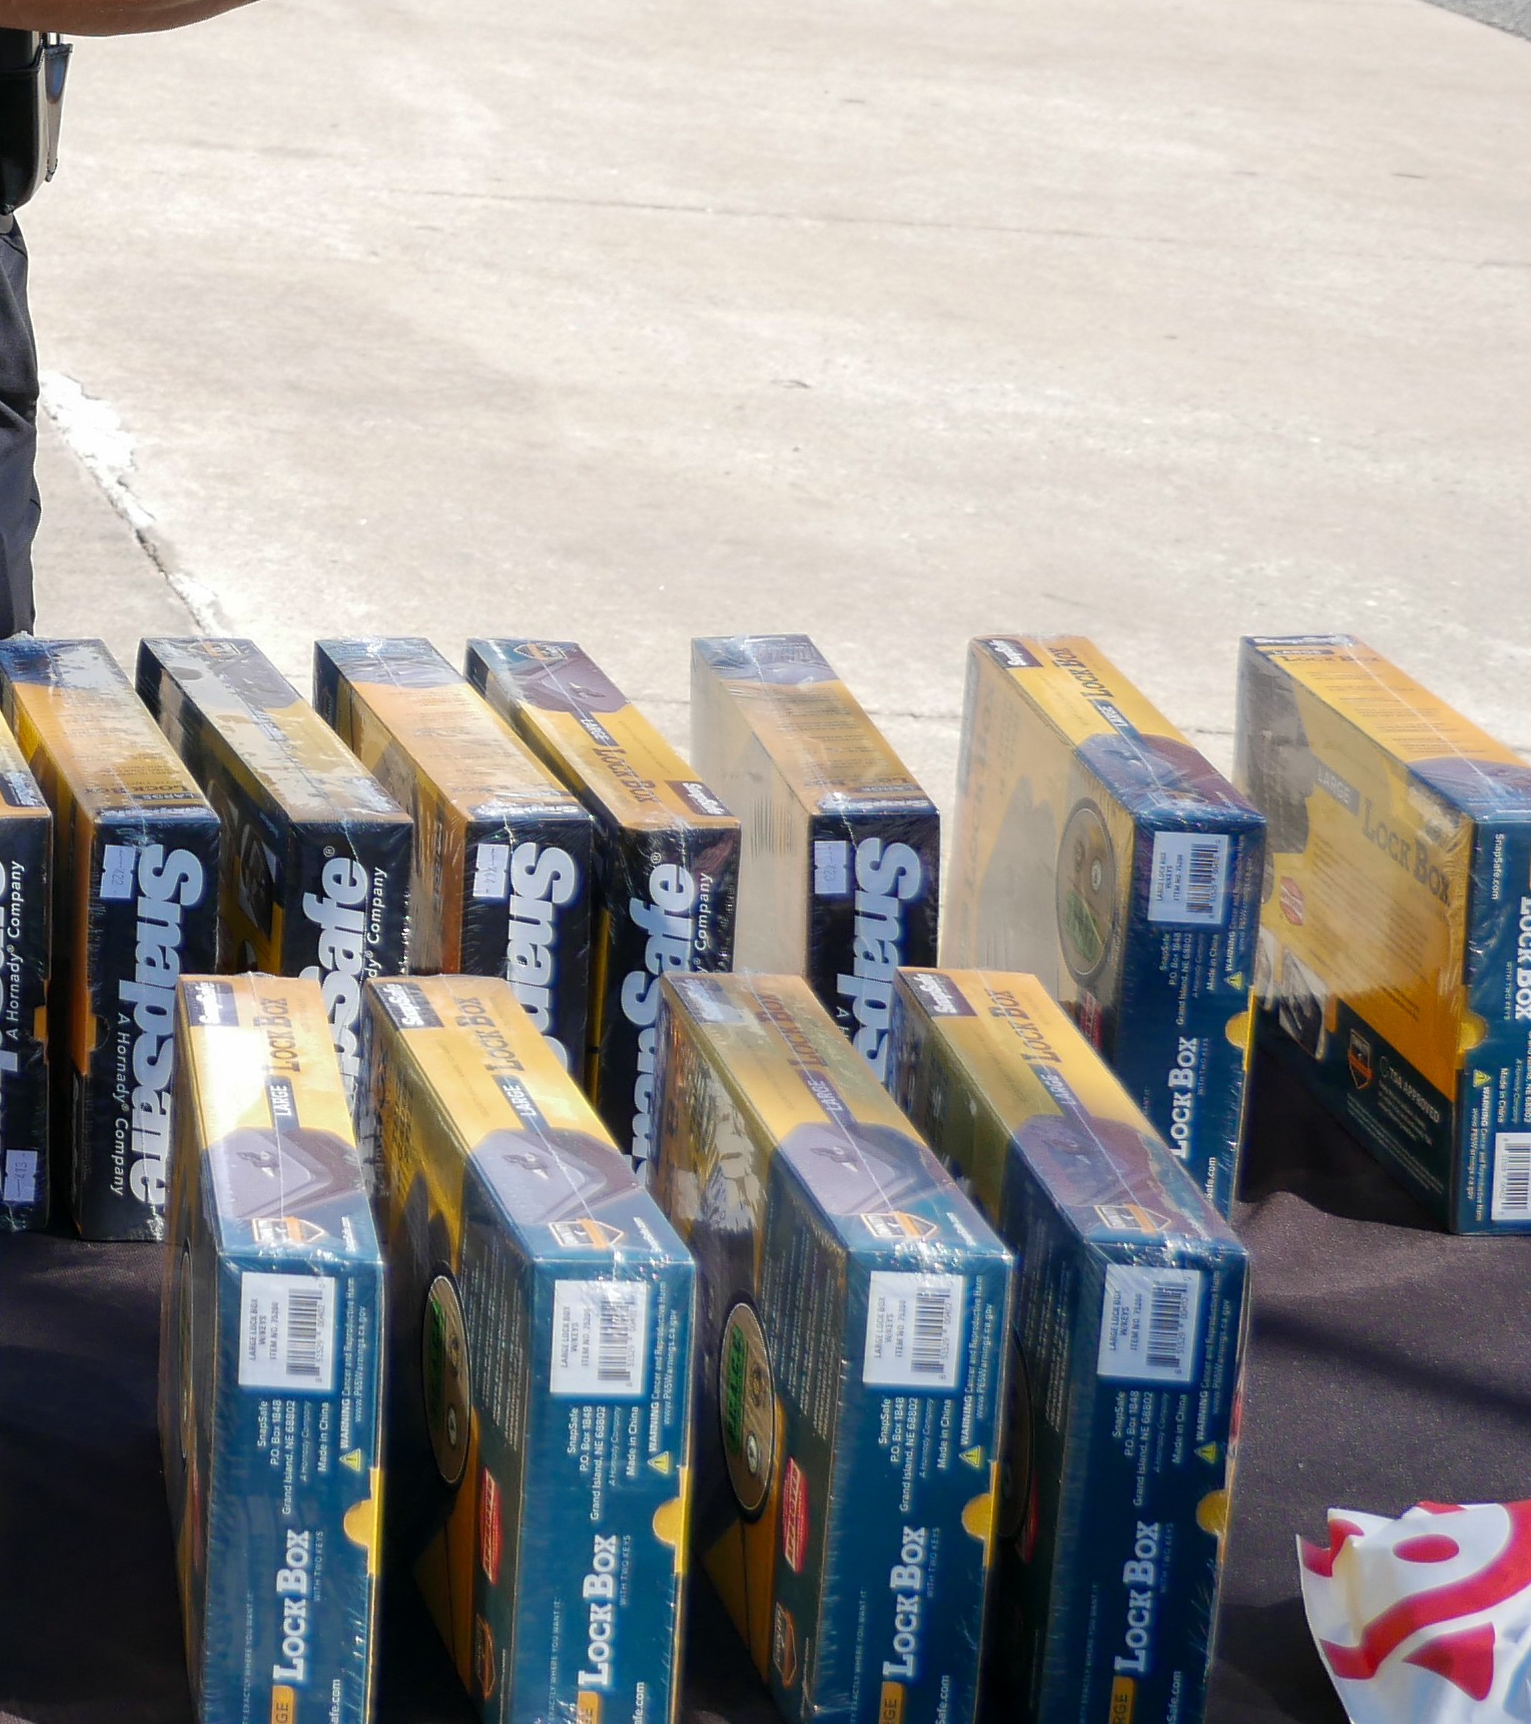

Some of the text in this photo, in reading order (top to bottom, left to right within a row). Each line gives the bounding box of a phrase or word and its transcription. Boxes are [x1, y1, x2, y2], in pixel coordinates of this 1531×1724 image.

[1318, 768, 1350, 805] LARGE
[5, 860, 26, 939] Company
[367, 866, 388, 945] Company
[1491, 832, 1505, 900] SnapSafe.com
[694, 872, 713, 952] Company
[6, 1027, 19, 1040] A
[115, 1013, 129, 1026] A
[252, 997, 301, 1117] LARGE LOCK BOX
[453, 996, 538, 1117] LARGE LOCK BOX
[1168, 1036, 1199, 1159] LOCK BOX
[110, 1117, 130, 1196] Company
[257, 1400, 269, 1447] SnapSafe
[270, 1398, 282, 1466] P.O. Box 1848
[282, 1399, 296, 1516] Grand Island, NE 68802
[317, 1402, 329, 1472] Made in China
[340, 1397, 351, 1449] WARNING
[273, 1529, 310, 1681] LOCK BOX
[578, 1534, 618, 1686] LOCK BOX
[883, 1526, 926, 1677] LOCK BOX
[1113, 1520, 1159, 1673] LOCK BOX
